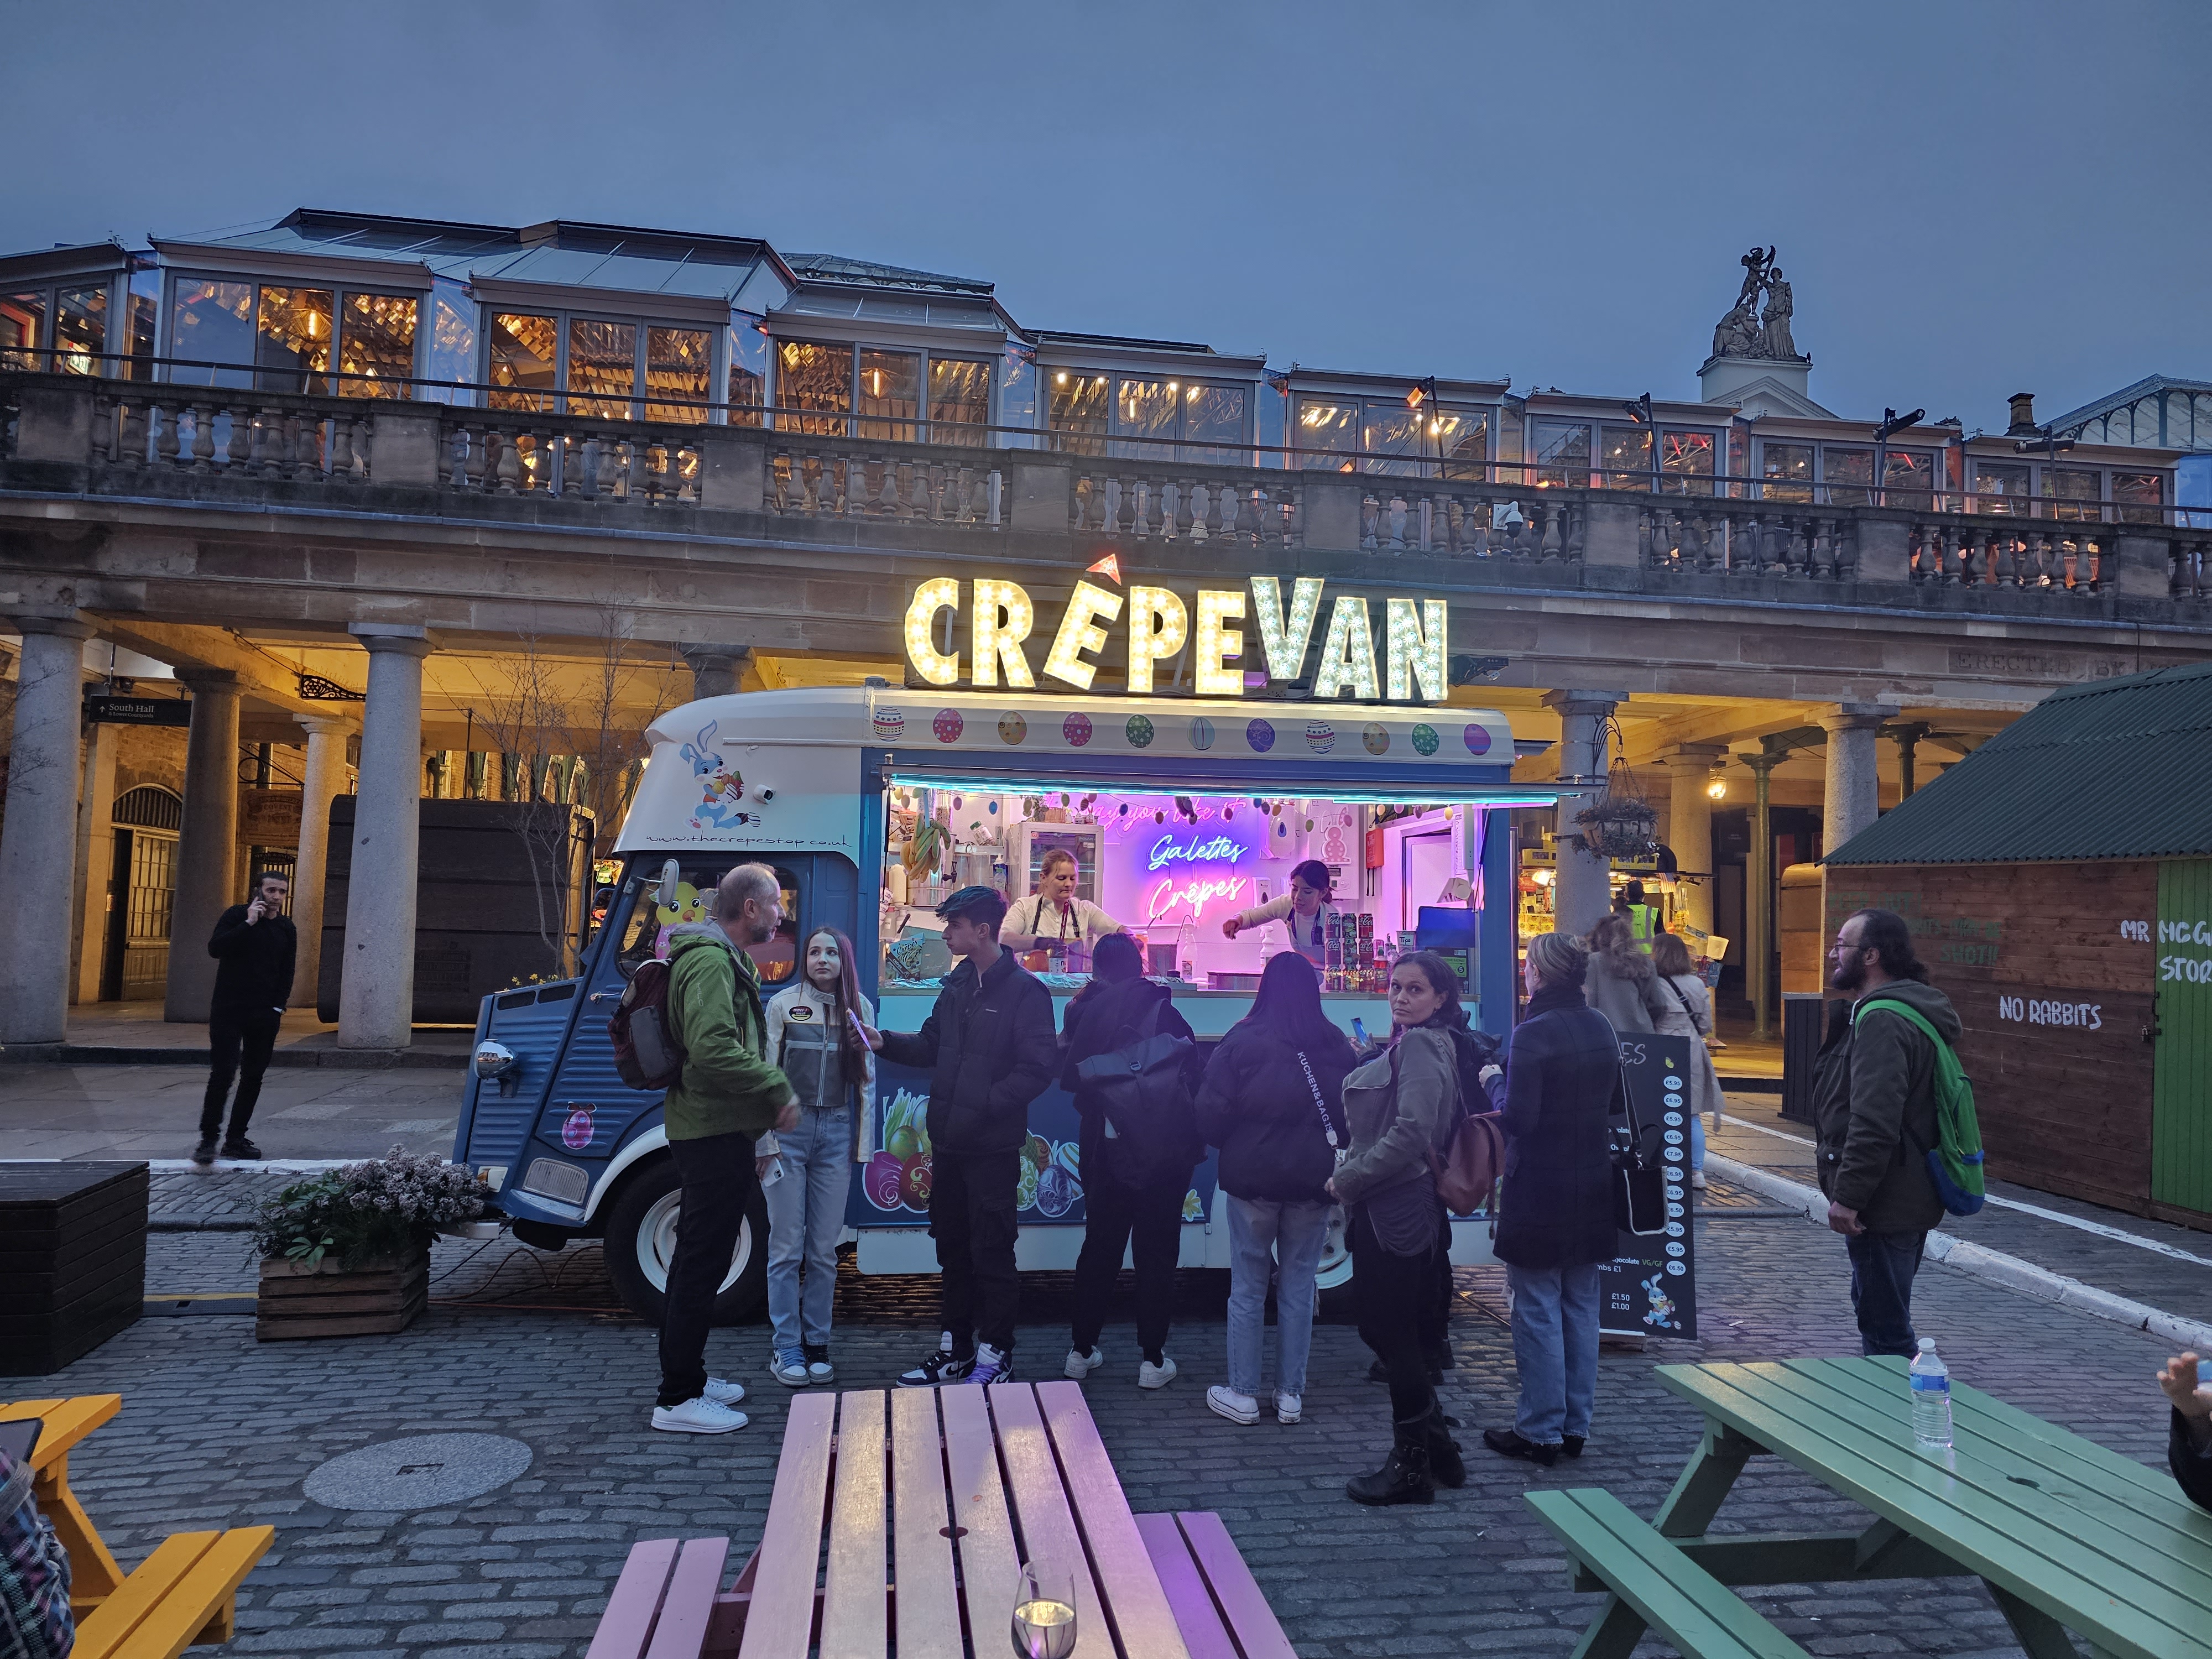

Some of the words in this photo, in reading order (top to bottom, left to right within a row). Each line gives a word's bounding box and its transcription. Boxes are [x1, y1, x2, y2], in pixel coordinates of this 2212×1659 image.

[1956, 652, 2072, 674] ERECTED
[2095, 660, 2126, 677] BY
[1149, 834, 1248, 871] Galettes
[1148, 875, 1248, 919] Crêpes
[1399, 936, 1411, 945] Tips
[2121, 920, 2150, 942] MR
[2159, 920, 2212, 946] MCG
[2000, 996, 2024, 1022] NO
[2029, 999, 2101, 1030] RABBITS
[1642, 1259, 1663, 1268] VG/GF
[1611, 1292, 1630, 1301] £1.50
[1611, 1302, 1630, 1311] £1.00
